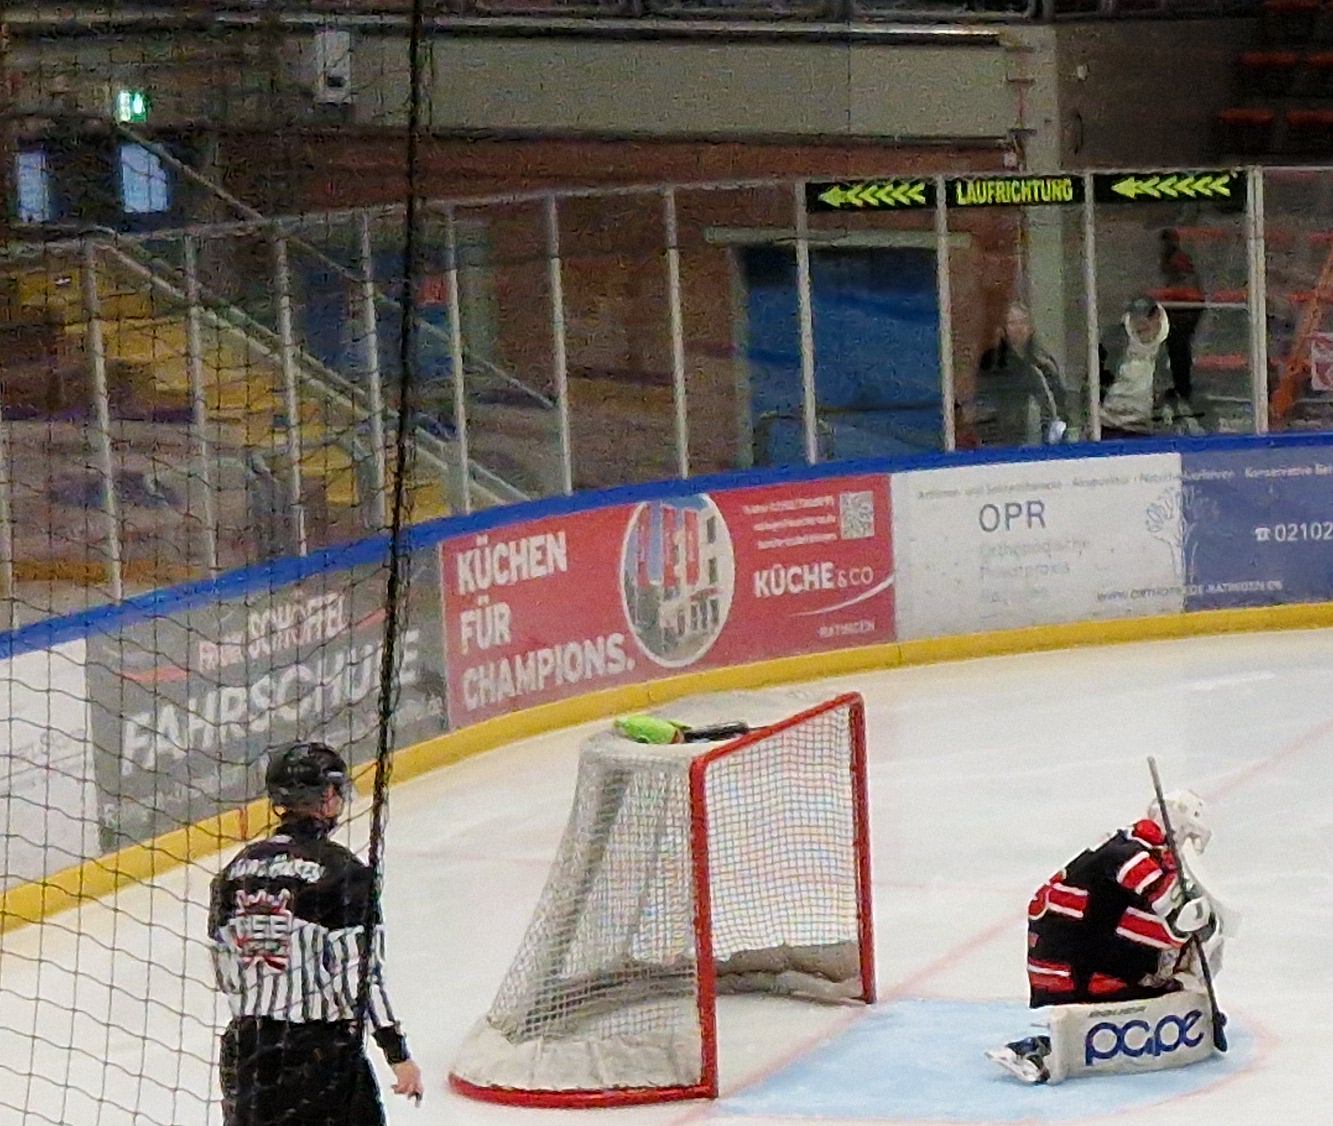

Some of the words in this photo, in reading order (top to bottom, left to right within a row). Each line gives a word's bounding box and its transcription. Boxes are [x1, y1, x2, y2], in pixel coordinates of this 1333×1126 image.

[955, 178, 1073, 205] LAUFRICHTUNG
[978, 499, 1047, 534] OPR
[456, 530, 569, 596] KÜCHEN
[460, 596, 512, 655] FÜR
[460, 632, 637, 712] CHAMPIONS.
